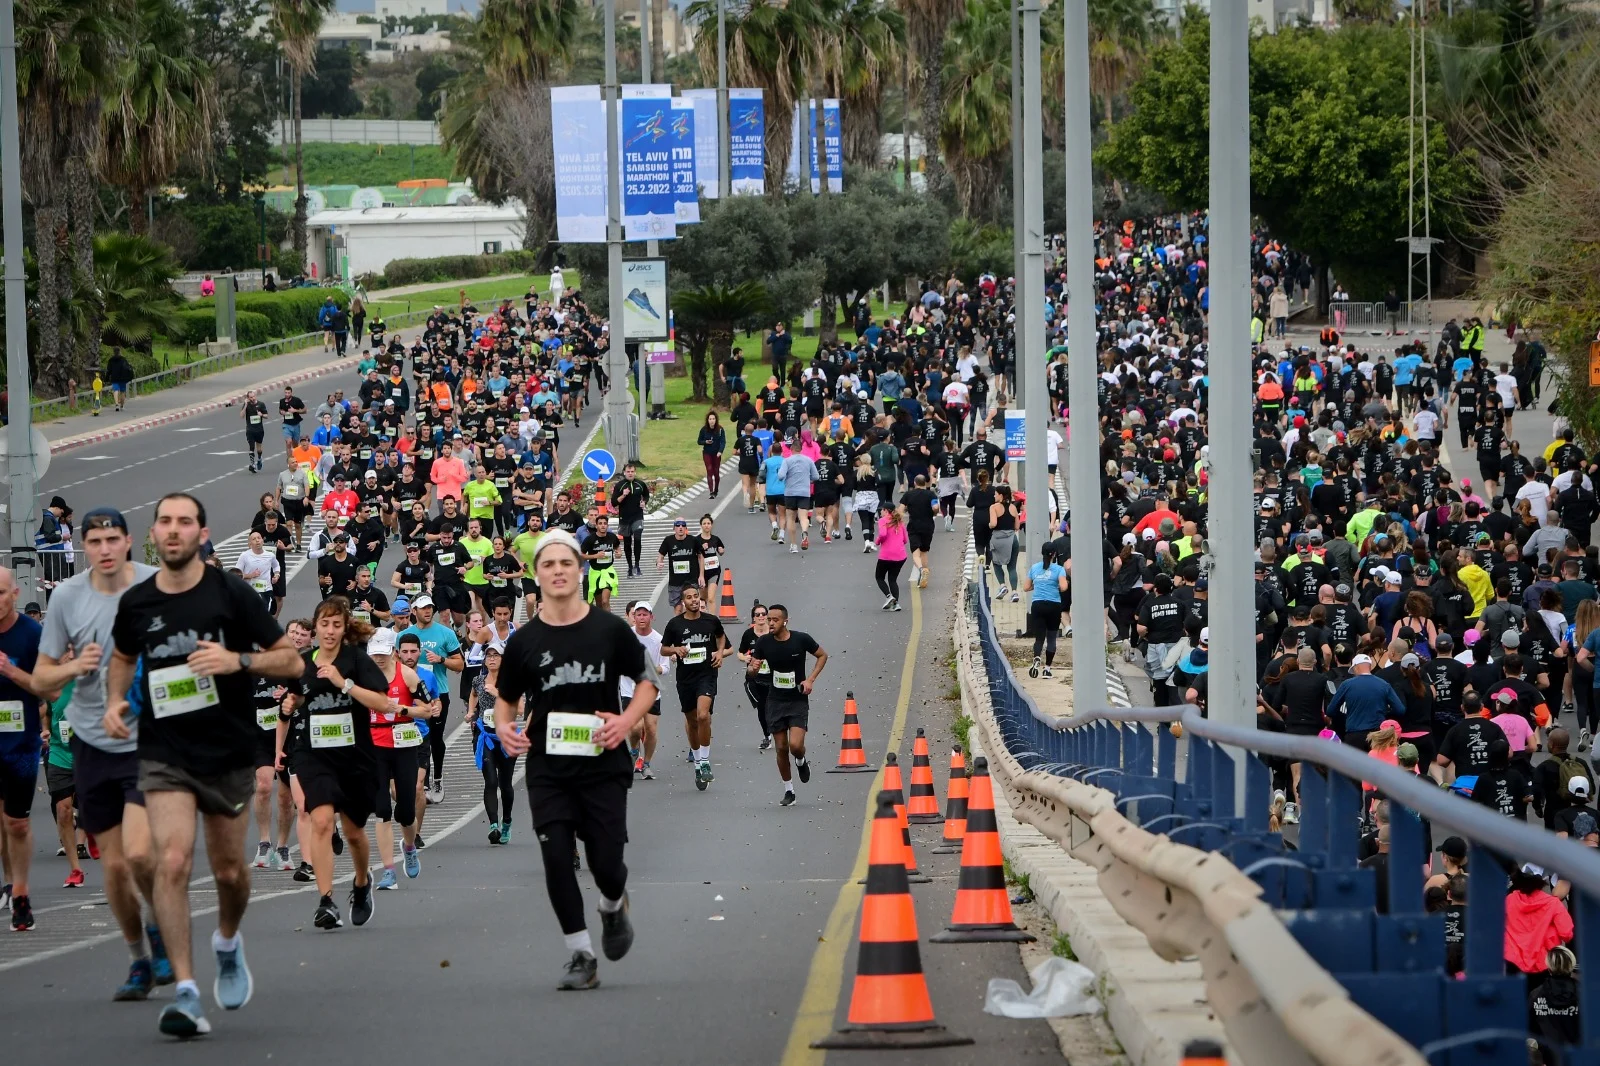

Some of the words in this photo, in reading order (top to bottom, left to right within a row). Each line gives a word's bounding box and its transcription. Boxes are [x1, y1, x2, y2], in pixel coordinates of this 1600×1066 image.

[626, 152, 643, 162] TEL
[646, 152, 668, 162] AVIV
[626, 163, 669, 172] SAMSUNG
[626, 173, 670, 182] MARATHON
[627, 184, 670, 195] 25.2.2022
[322, 726, 341, 736] 35091
[564, 728, 590, 740] 31912
